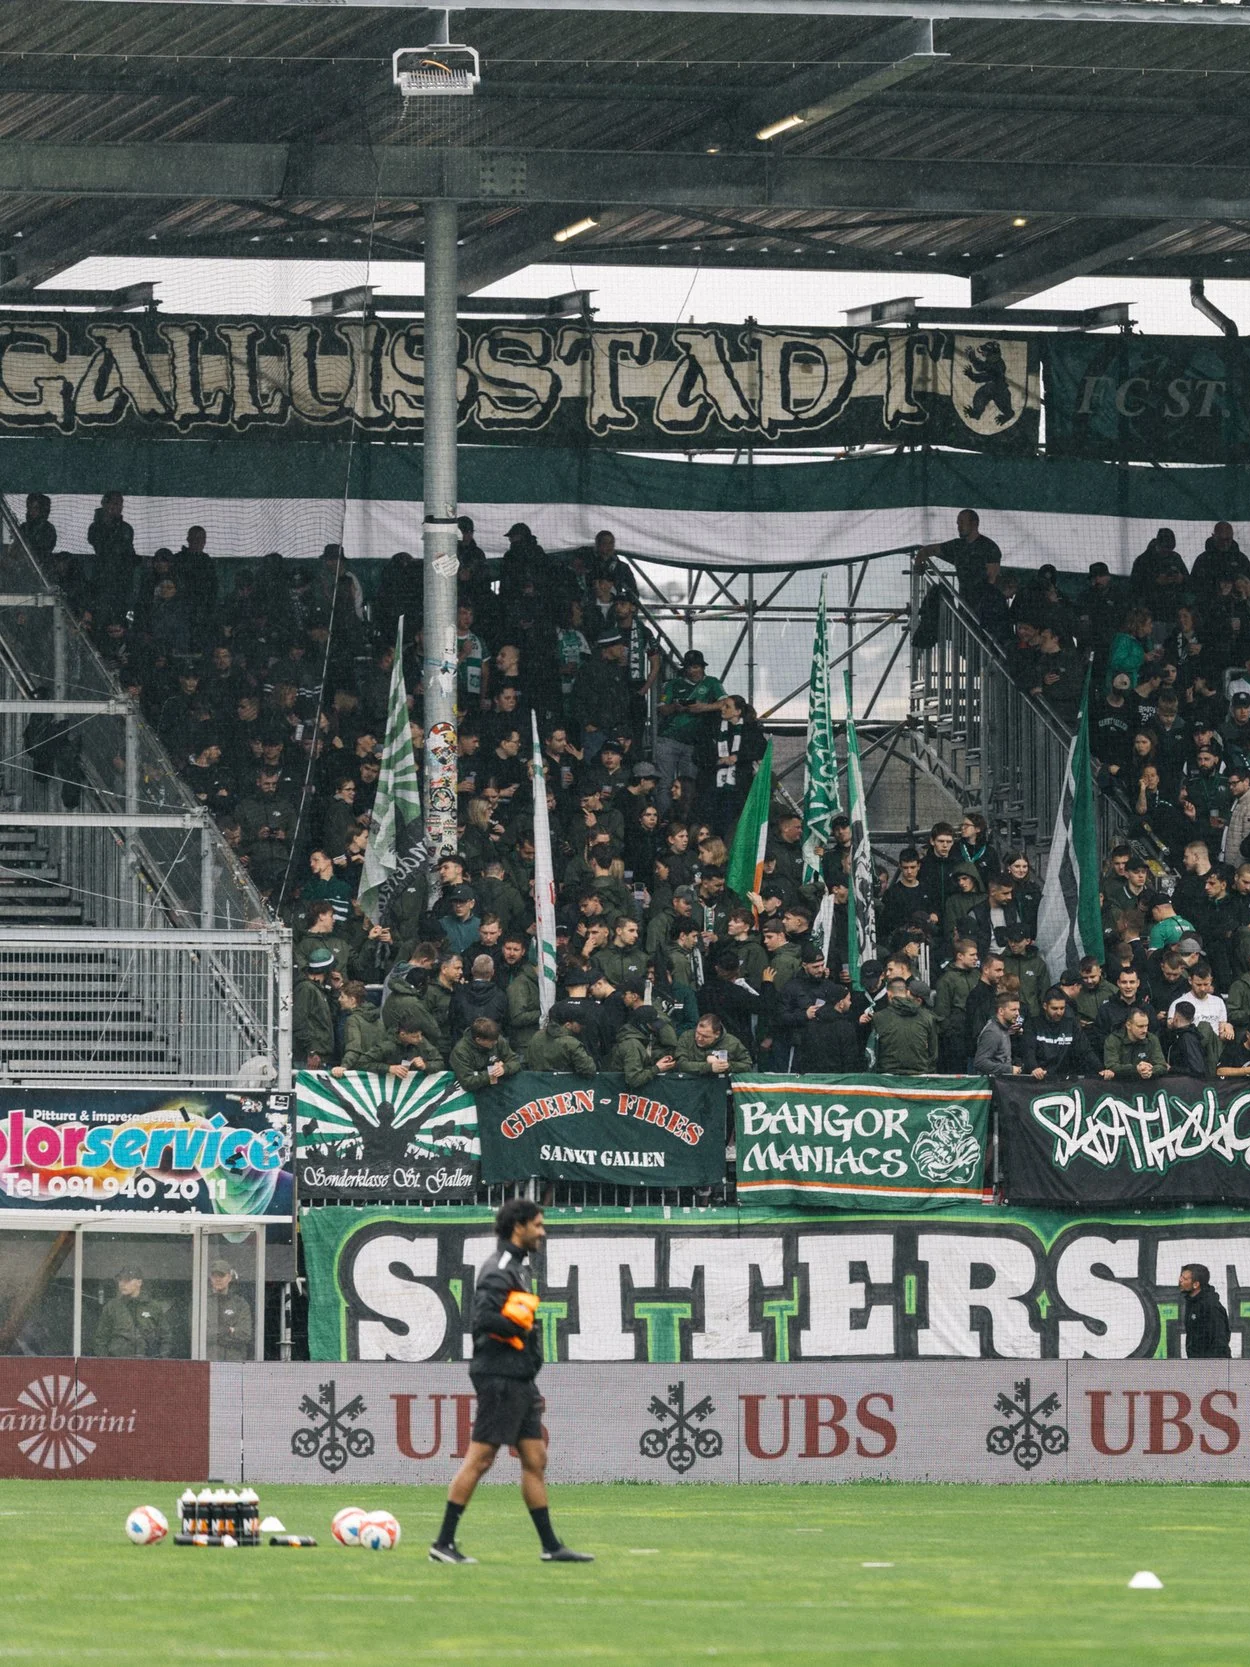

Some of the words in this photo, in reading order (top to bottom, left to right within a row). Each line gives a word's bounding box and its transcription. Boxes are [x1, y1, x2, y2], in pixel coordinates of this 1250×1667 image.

[1077, 376, 1152, 417] FC
[1163, 378, 1232, 418] ST.
[33, 1109, 76, 1121] Pittura
[79, 1110, 89, 1121] &
[92, 1111, 141, 1124] impresa
[500, 1089, 594, 1139] GREEN
[617, 1092, 704, 1146] FIRES
[739, 1101, 911, 1142] BANGOR
[540, 1144, 597, 1166] SANKT
[601, 1150, 665, 1167] GALLEN
[741, 1142, 909, 1178] MANIACS
[2, 1174, 39, 1197] Tel
[48, 1176, 94, 1198] 091
[103, 1176, 156, 1199] 940
[163, 1178, 200, 1200] 20
[208, 1178, 226, 1200] 11
[304, 1166, 390, 1188] Sonderklasse
[425, 1167, 473, 1193] Gallen
[0, 1405, 137, 1433] amborini
[738, 1392, 897, 1461] UBS
[1085, 1389, 1242, 1456] UBS
